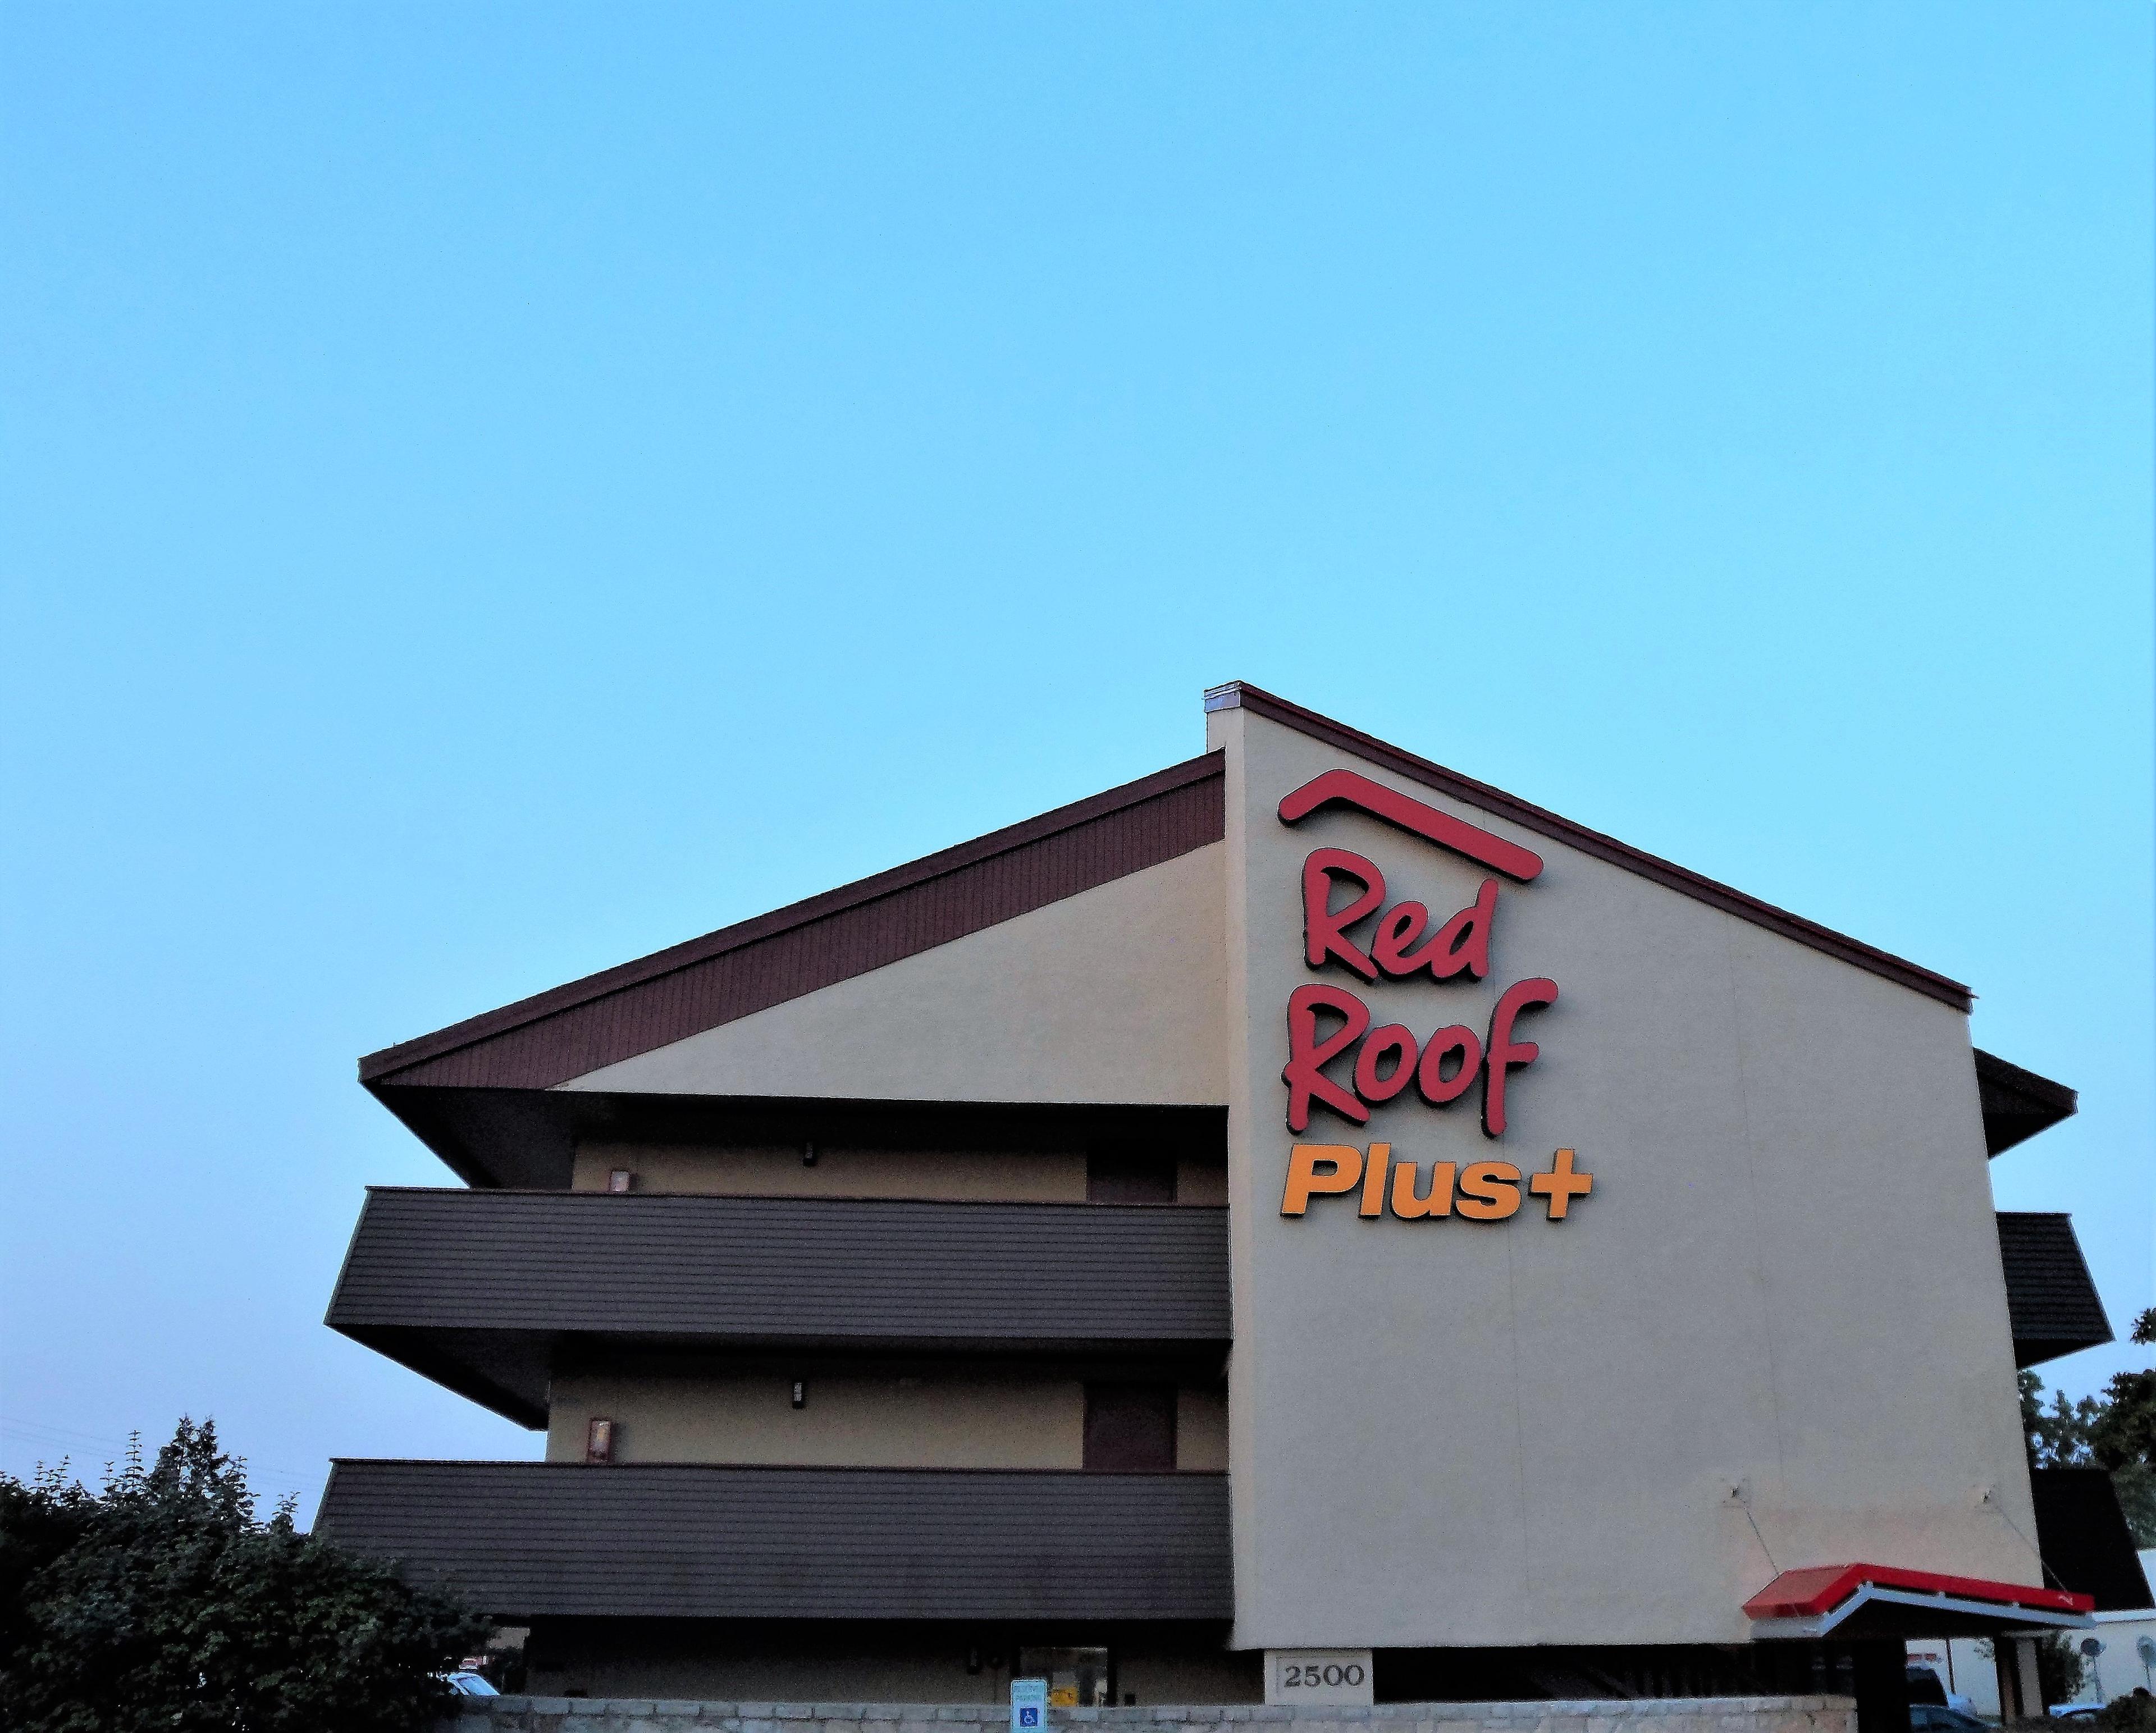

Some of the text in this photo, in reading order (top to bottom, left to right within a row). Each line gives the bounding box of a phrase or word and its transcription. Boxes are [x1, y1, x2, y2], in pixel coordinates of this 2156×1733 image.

[1303, 848, 1499, 978] Red
[1285, 977, 1559, 1135] Roof
[1282, 1143, 1593, 1219] Plus+
[1284, 1665, 1364, 1686] 2500
